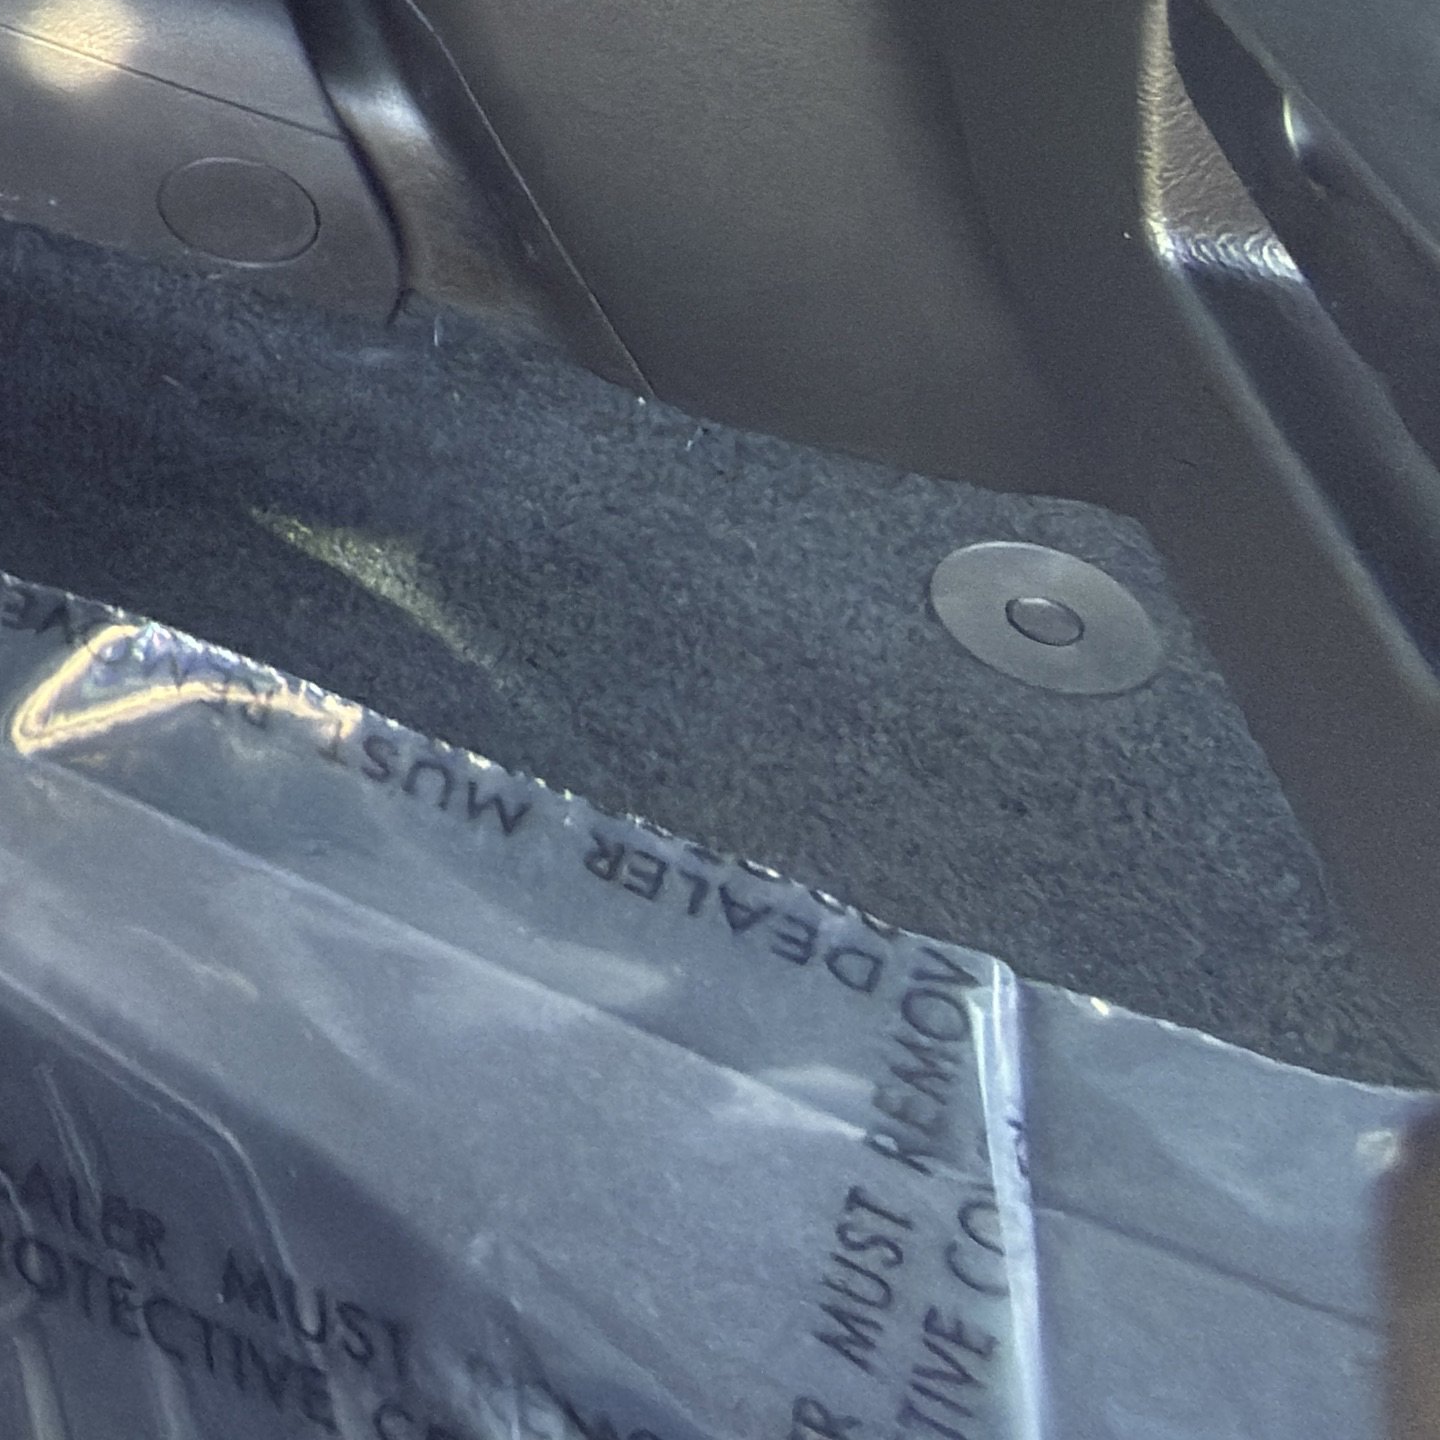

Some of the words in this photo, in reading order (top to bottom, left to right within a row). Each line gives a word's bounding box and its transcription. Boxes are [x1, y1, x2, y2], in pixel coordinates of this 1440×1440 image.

[318, 720, 531, 836] MUST
[584, 826, 884, 994] DEALER
[814, 1184, 914, 1374] MUST
[866, 945, 982, 1177] REMOV
[220, 1247, 411, 1377] MUST
